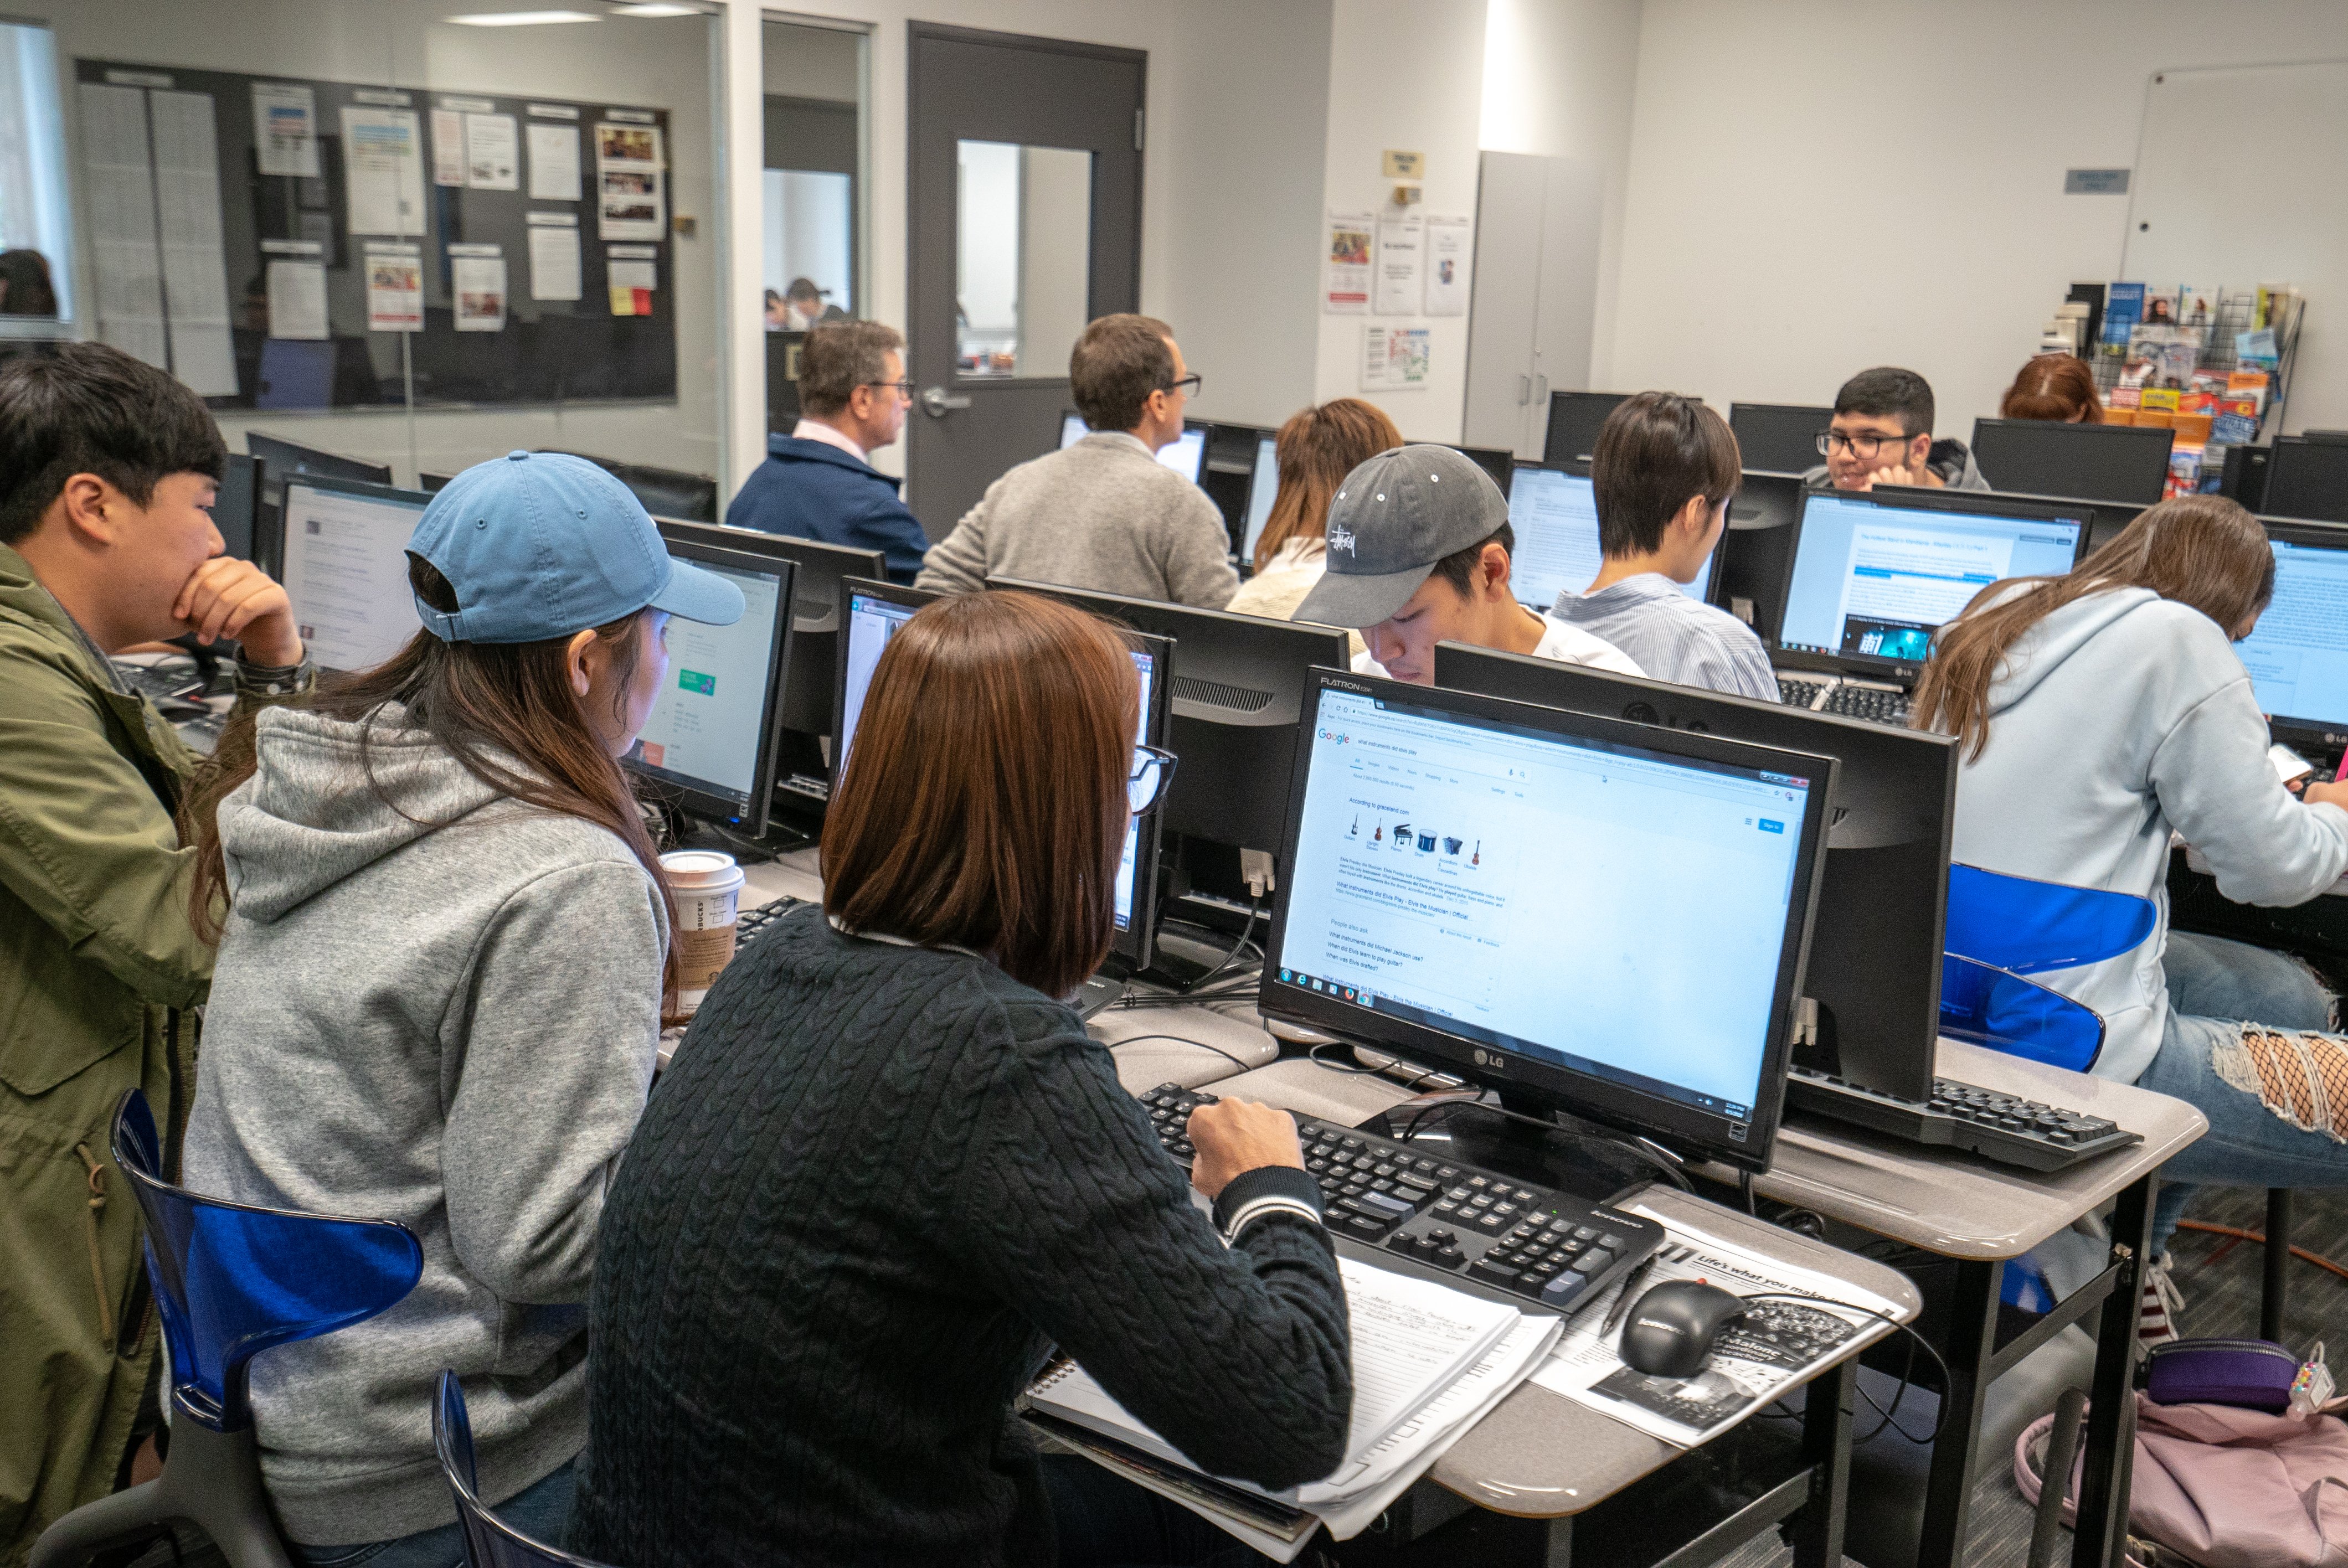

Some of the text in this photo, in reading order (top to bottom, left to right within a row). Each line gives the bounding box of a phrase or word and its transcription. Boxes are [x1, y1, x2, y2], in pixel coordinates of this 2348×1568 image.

[1321, 677, 1361, 690] FLATRON
[1317, 727, 1350, 746] Google
[1368, 741, 1391, 749] instruments
[1348, 797, 1371, 808] According
[1348, 884, 1374, 895] instruments
[1394, 896, 1404, 904] Play
[1428, 905, 1449, 915] Musician
[1452, 911, 1469, 920] Official
[1330, 919, 1348, 929] People
[1341, 935, 1366, 946] instruments
[1374, 944, 1392, 953] Michael
[1392, 949, 1411, 959] Jackson
[1412, 954, 1424, 962] use?
[1360, 962, 1378, 971] drafted?
[1376, 956, 1386, 964] play
[1387, 958, 1403, 968] guitar?
[1335, 978, 1359, 989] instruments
[1413, 1000, 1433, 1011] Musician
[1489, 1057, 1504, 1069] LG
[1590, 1210, 1643, 1228] lenovo
[1659, 1241, 1700, 1265] 11
[1698, 1255, 1729, 1270] Life's
[1731, 1265, 1763, 1282] what
[1764, 1278, 1789, 1291] you
[1790, 1285, 1825, 1301] make
